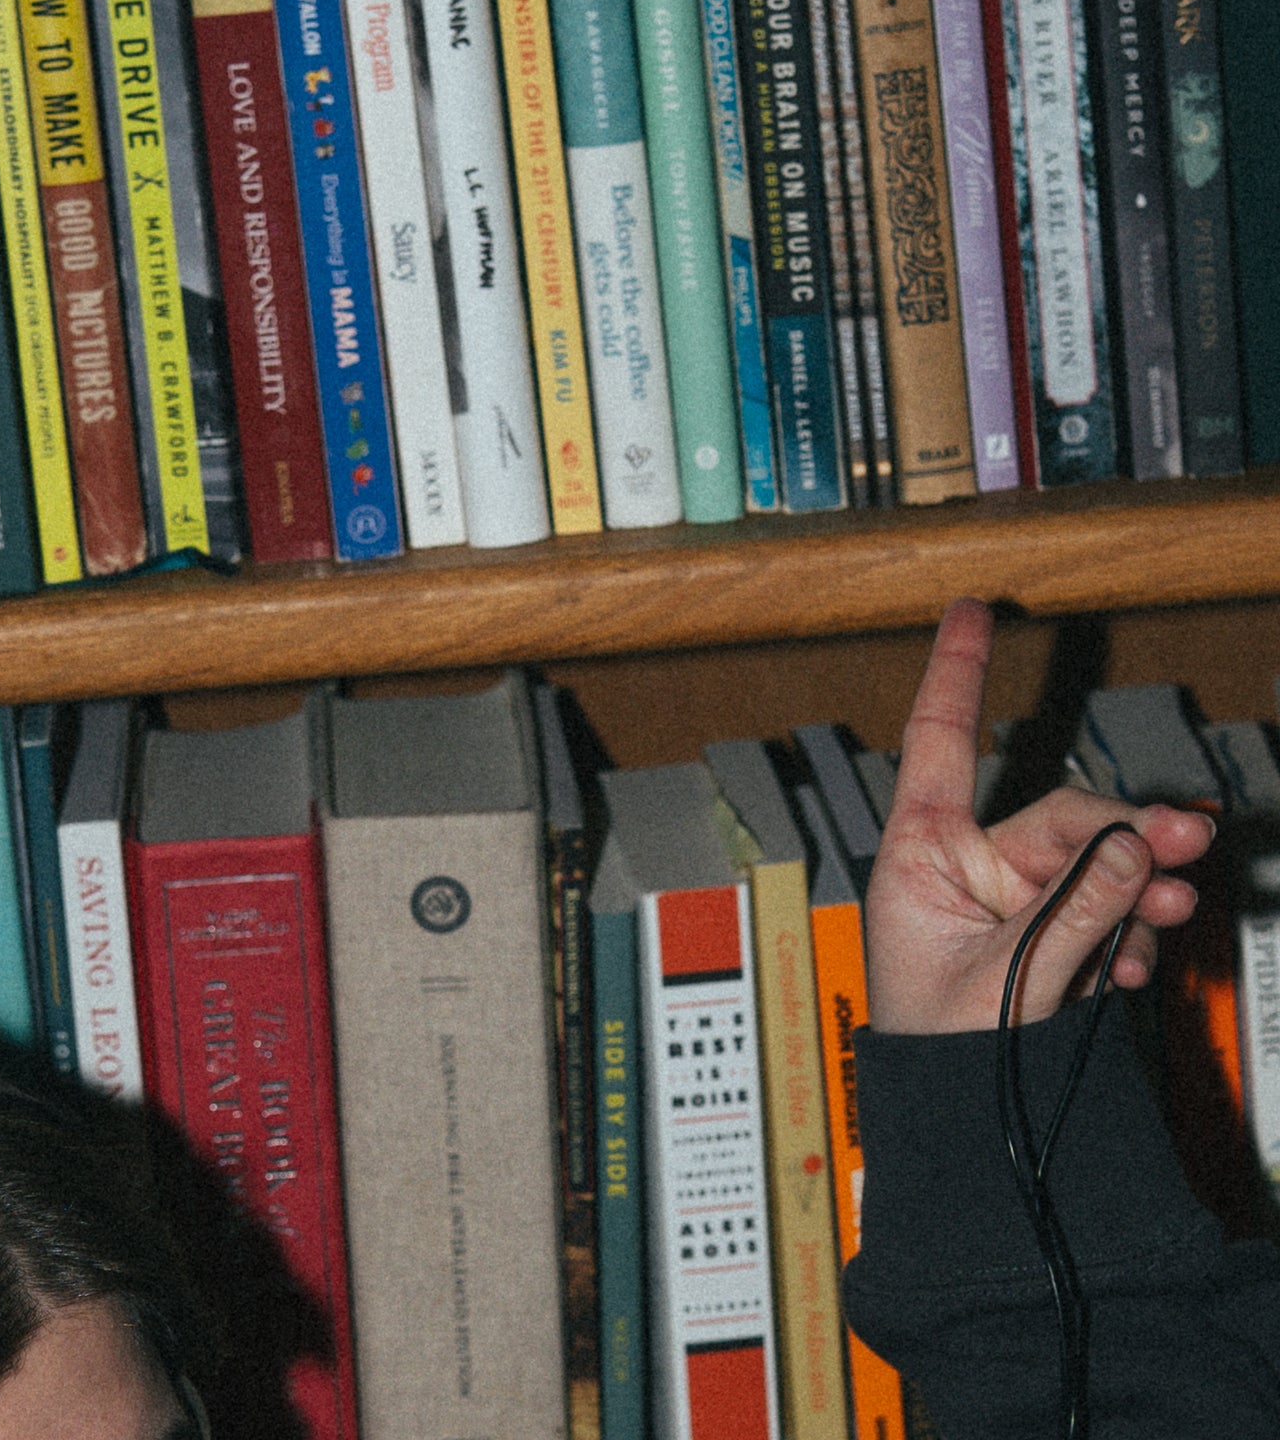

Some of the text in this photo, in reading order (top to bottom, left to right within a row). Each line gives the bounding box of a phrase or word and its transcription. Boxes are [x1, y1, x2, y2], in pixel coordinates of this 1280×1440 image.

[32, 38, 75, 75] TO
[358, 2, 401, 93] Program
[40, 92, 87, 170] MAKE
[117, 37, 159, 150] DRIVE
[521, 82, 543, 111] OF
[771, 62, 802, 150] BRAIN
[1122, 71, 1149, 158] MERCY
[524, 119, 548, 158] THE
[780, 161, 805, 197] ON
[12, 197, 36, 290] HOSPITALITY
[53, 196, 100, 273] GOOD
[224, 61, 292, 417] LOVE AND RESPONSIBILITY
[534, 212, 565, 310] CENTURY
[784, 210, 815, 302] MUSIC
[587, 239, 623, 358] gets cold
[608, 184, 653, 400] Before the coffee
[143, 215, 190, 479] MATTHEW B. CRAWFORD
[547, 329, 575, 405] KIM FU
[73, 855, 112, 988] SAVING
[198, 979, 242, 1118] GREAT
[669, 1036, 744, 1057] REST
[602, 1019, 627, 1197] SIDE BY SIDE
[673, 1090, 747, 1107] NOISE
[681, 1218, 754, 1236] ALEX
[681, 1240, 756, 1259] ROSS
